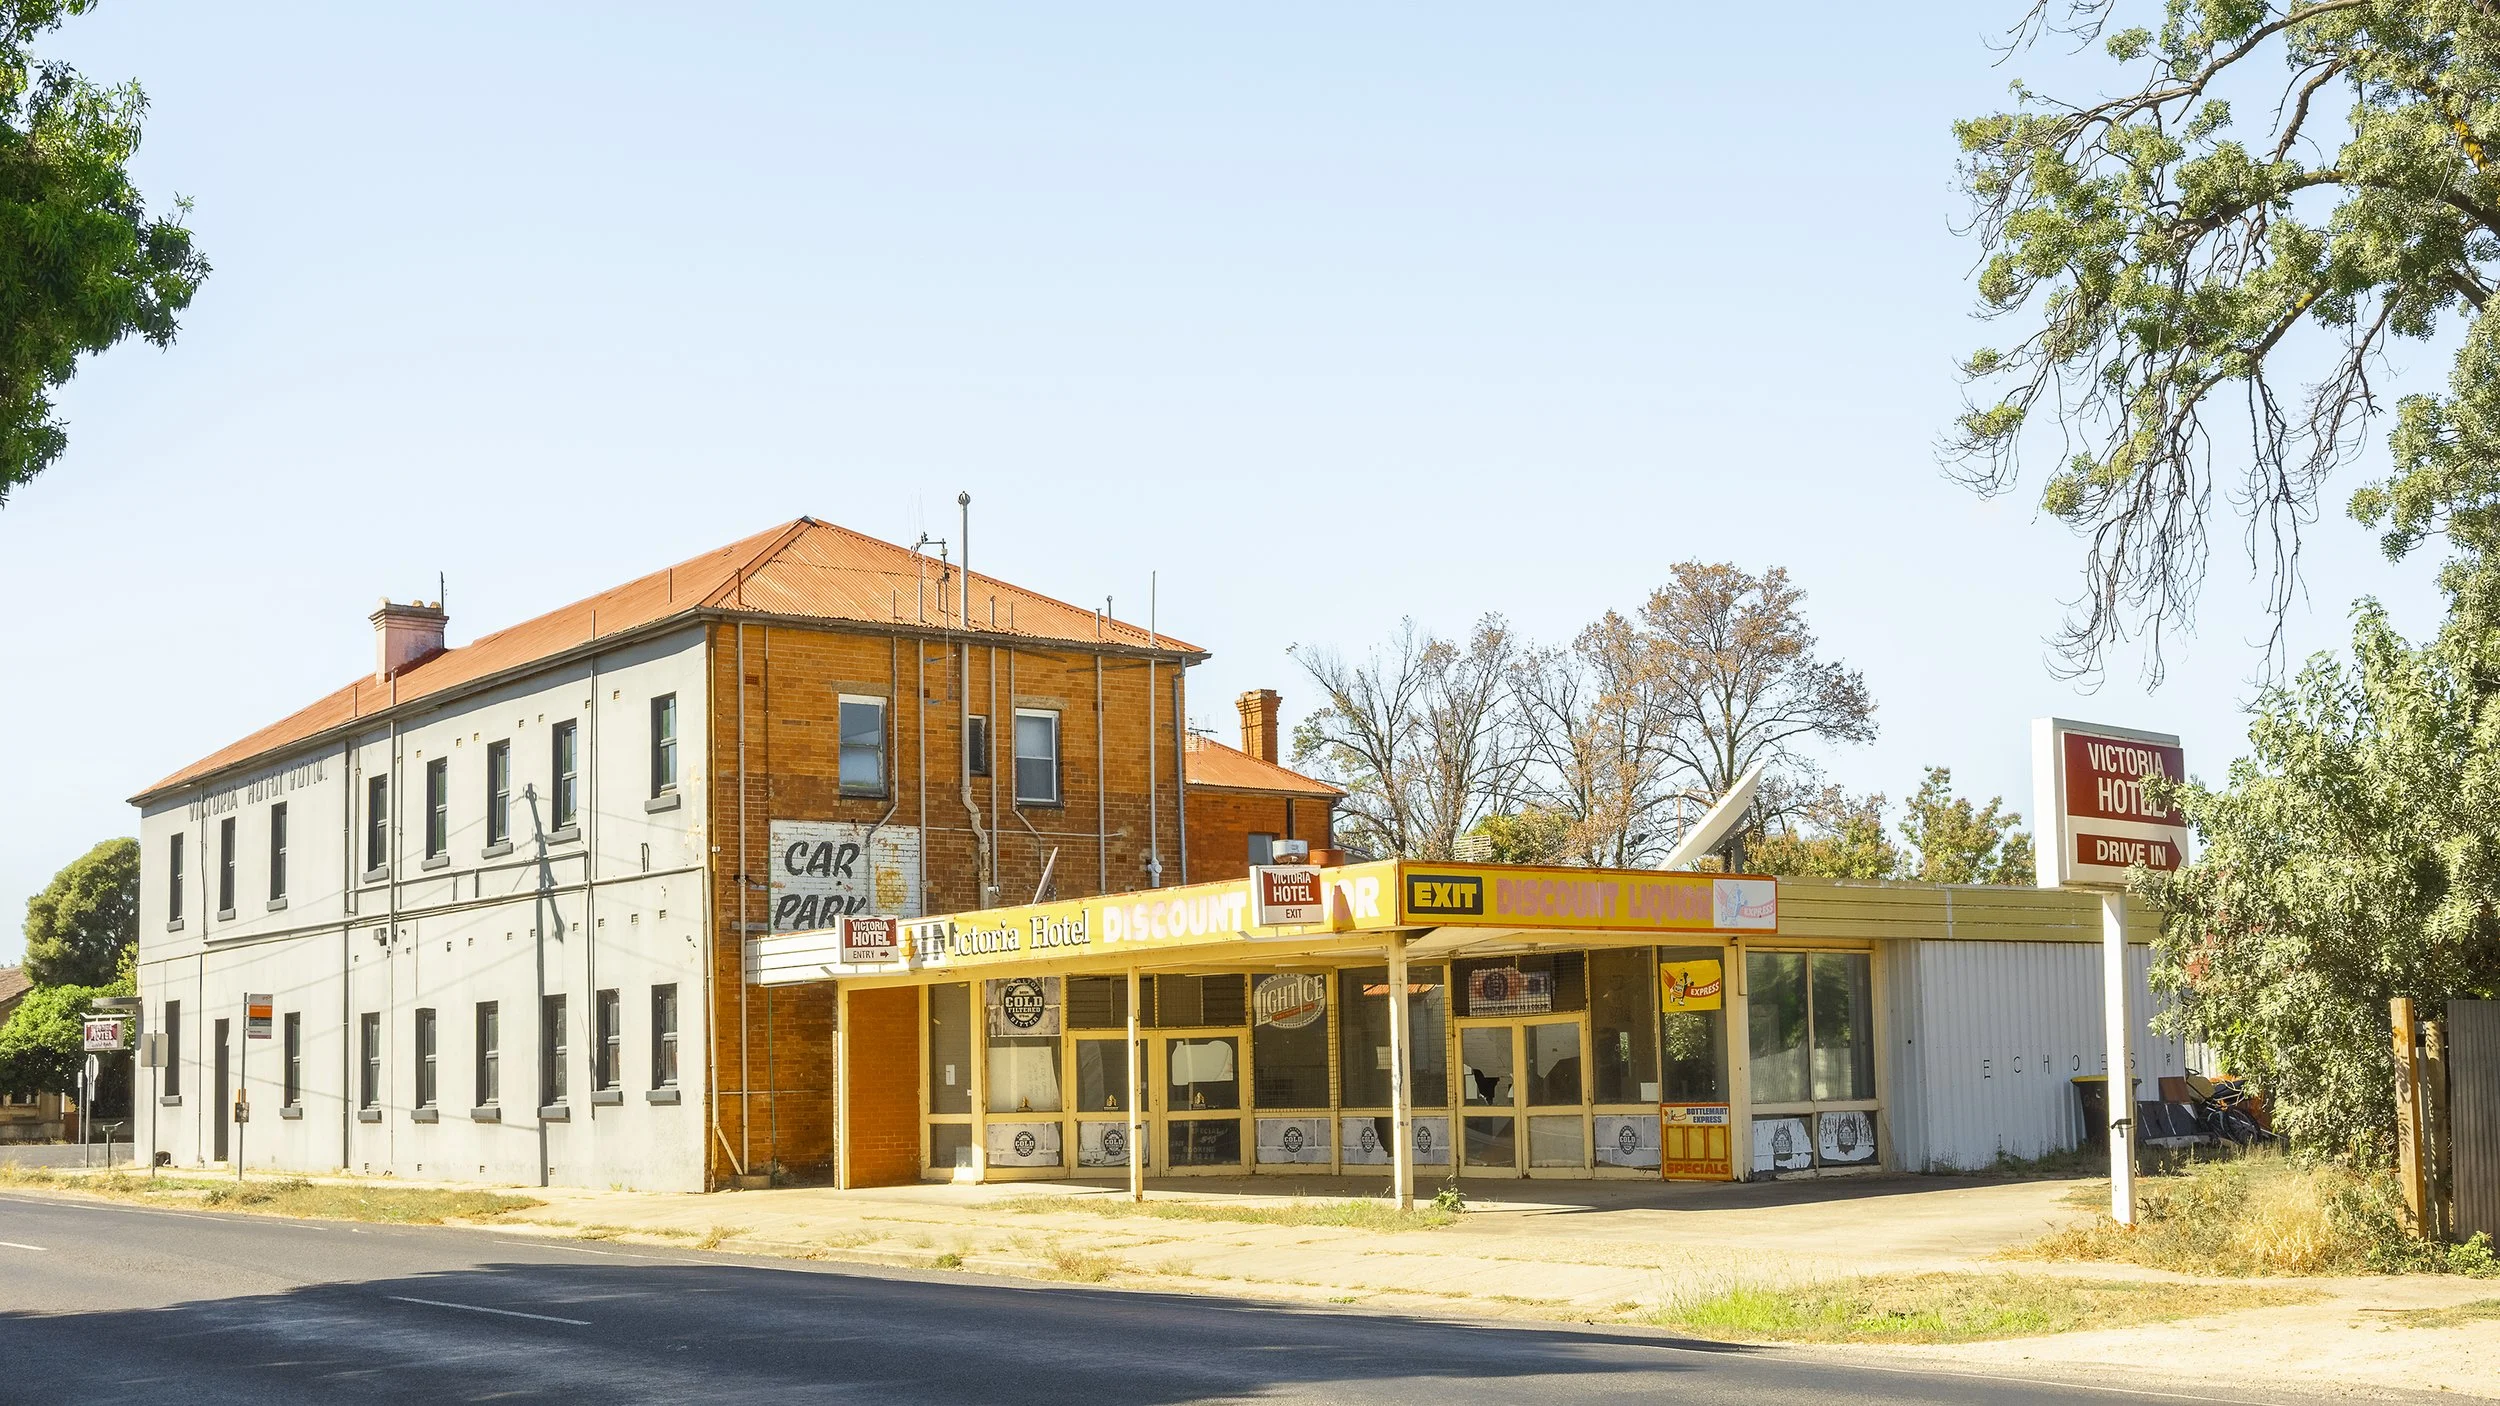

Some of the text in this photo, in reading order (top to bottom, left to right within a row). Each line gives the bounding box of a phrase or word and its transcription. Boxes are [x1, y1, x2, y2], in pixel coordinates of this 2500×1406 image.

[2087, 742, 2166, 779] VICTORIA
[188, 786, 239, 822] VICTORIA
[784, 840, 861, 879] CAR
[2096, 839, 2167, 866] DRIVE IN
[1272, 872, 1312, 885] VICTORIA
[1273, 885, 1314, 903] HOTEL
[1414, 881, 1477, 909] EXIT
[1496, 878, 1713, 925] DISCOUNT LIQUOR
[1103, 891, 1247, 943] DISCOUNT
[1285, 908, 1302, 919] EXIT
[1743, 902, 1775, 918] EXPRESS
[851, 921, 890, 932] VICTORIA
[955, 909, 1091, 957] ictoria Hotel
[852, 931, 891, 947] HOTEL
[853, 950, 875, 960] ENTRY
[1690, 981, 1720, 996] EXPRESS
[1005, 996, 1043, 1008] COLD
[1254, 982, 1298, 1027] LIGHT
[1296, 974, 1325, 1014] ICE
[1010, 1015, 1039, 1027] BITTER
[1686, 1107, 1728, 1116] BOTTLEMART
[1692, 1115, 1723, 1124] EXPRESS
[1666, 1162, 1729, 1175] SPECIALS
